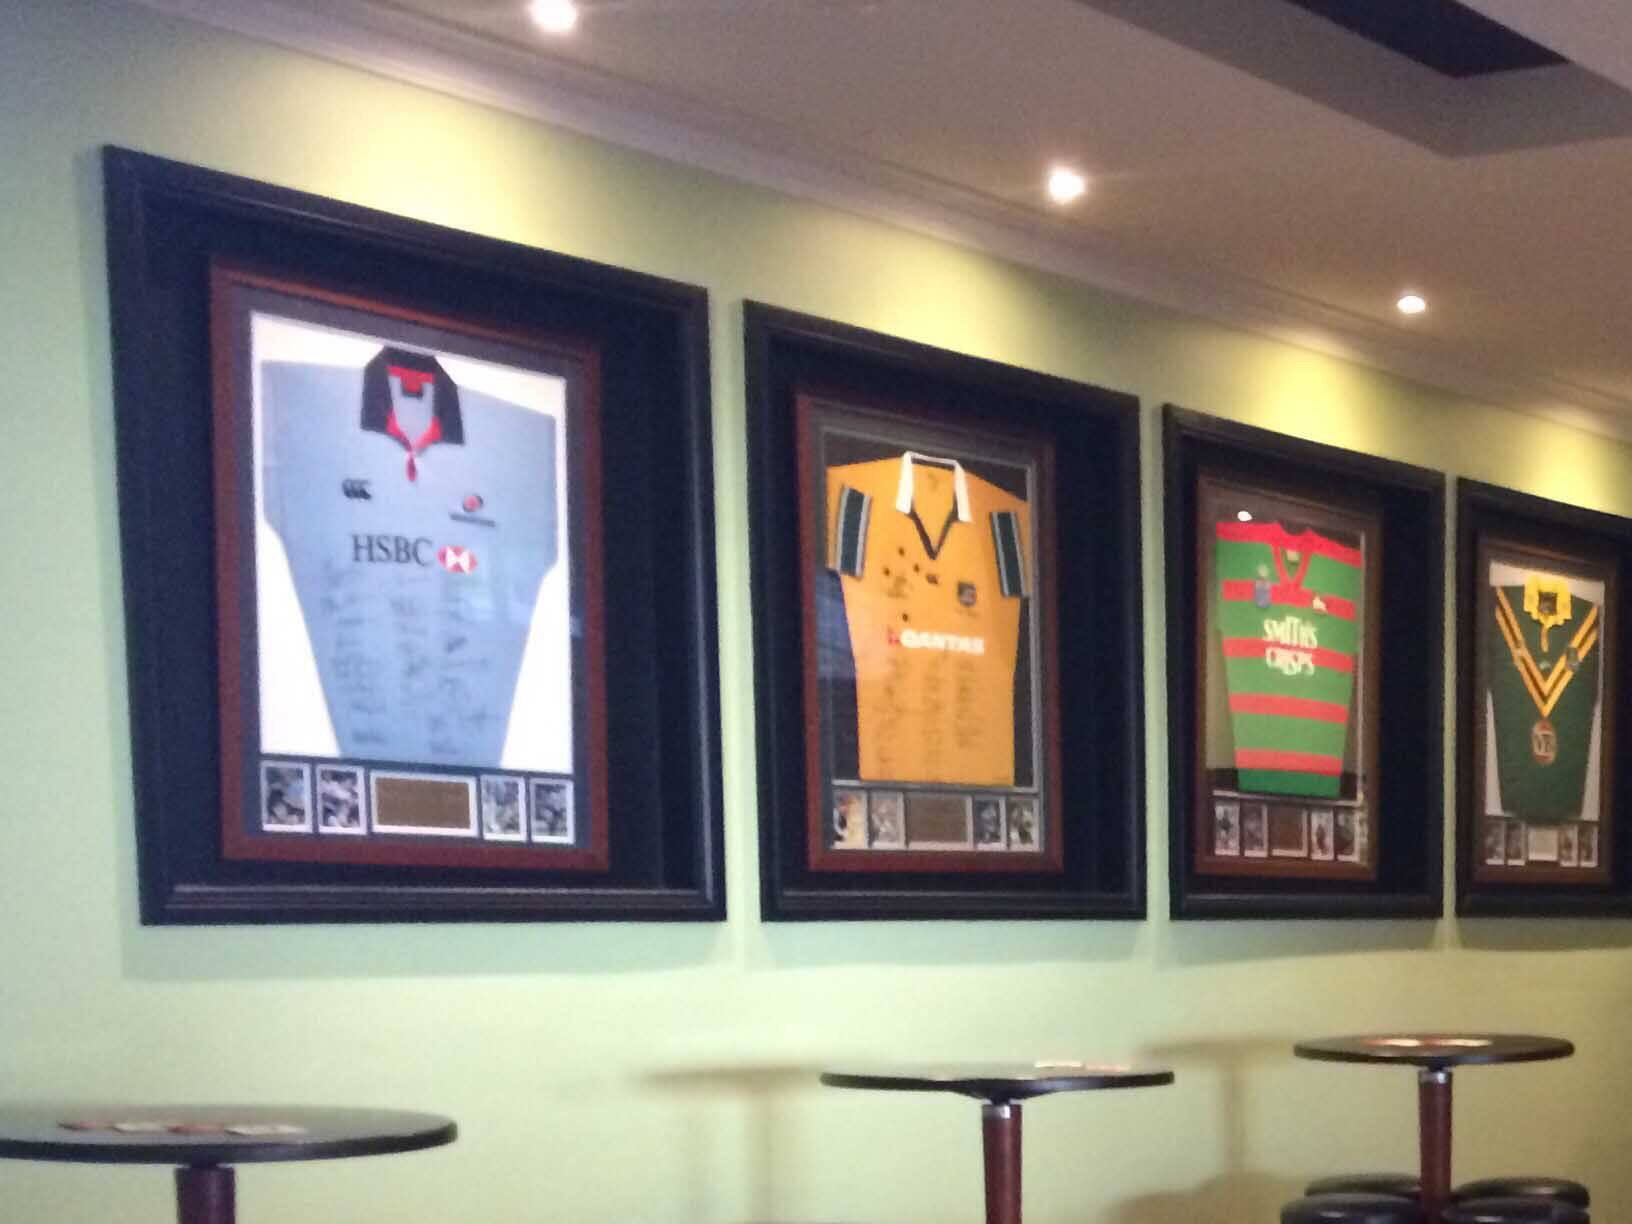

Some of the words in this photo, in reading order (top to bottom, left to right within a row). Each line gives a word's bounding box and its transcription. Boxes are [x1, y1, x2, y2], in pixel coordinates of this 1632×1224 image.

[351, 533, 432, 567] HSBC
[900, 629, 984, 656] QANTAS
[1264, 647, 1315, 676] CRISPS
